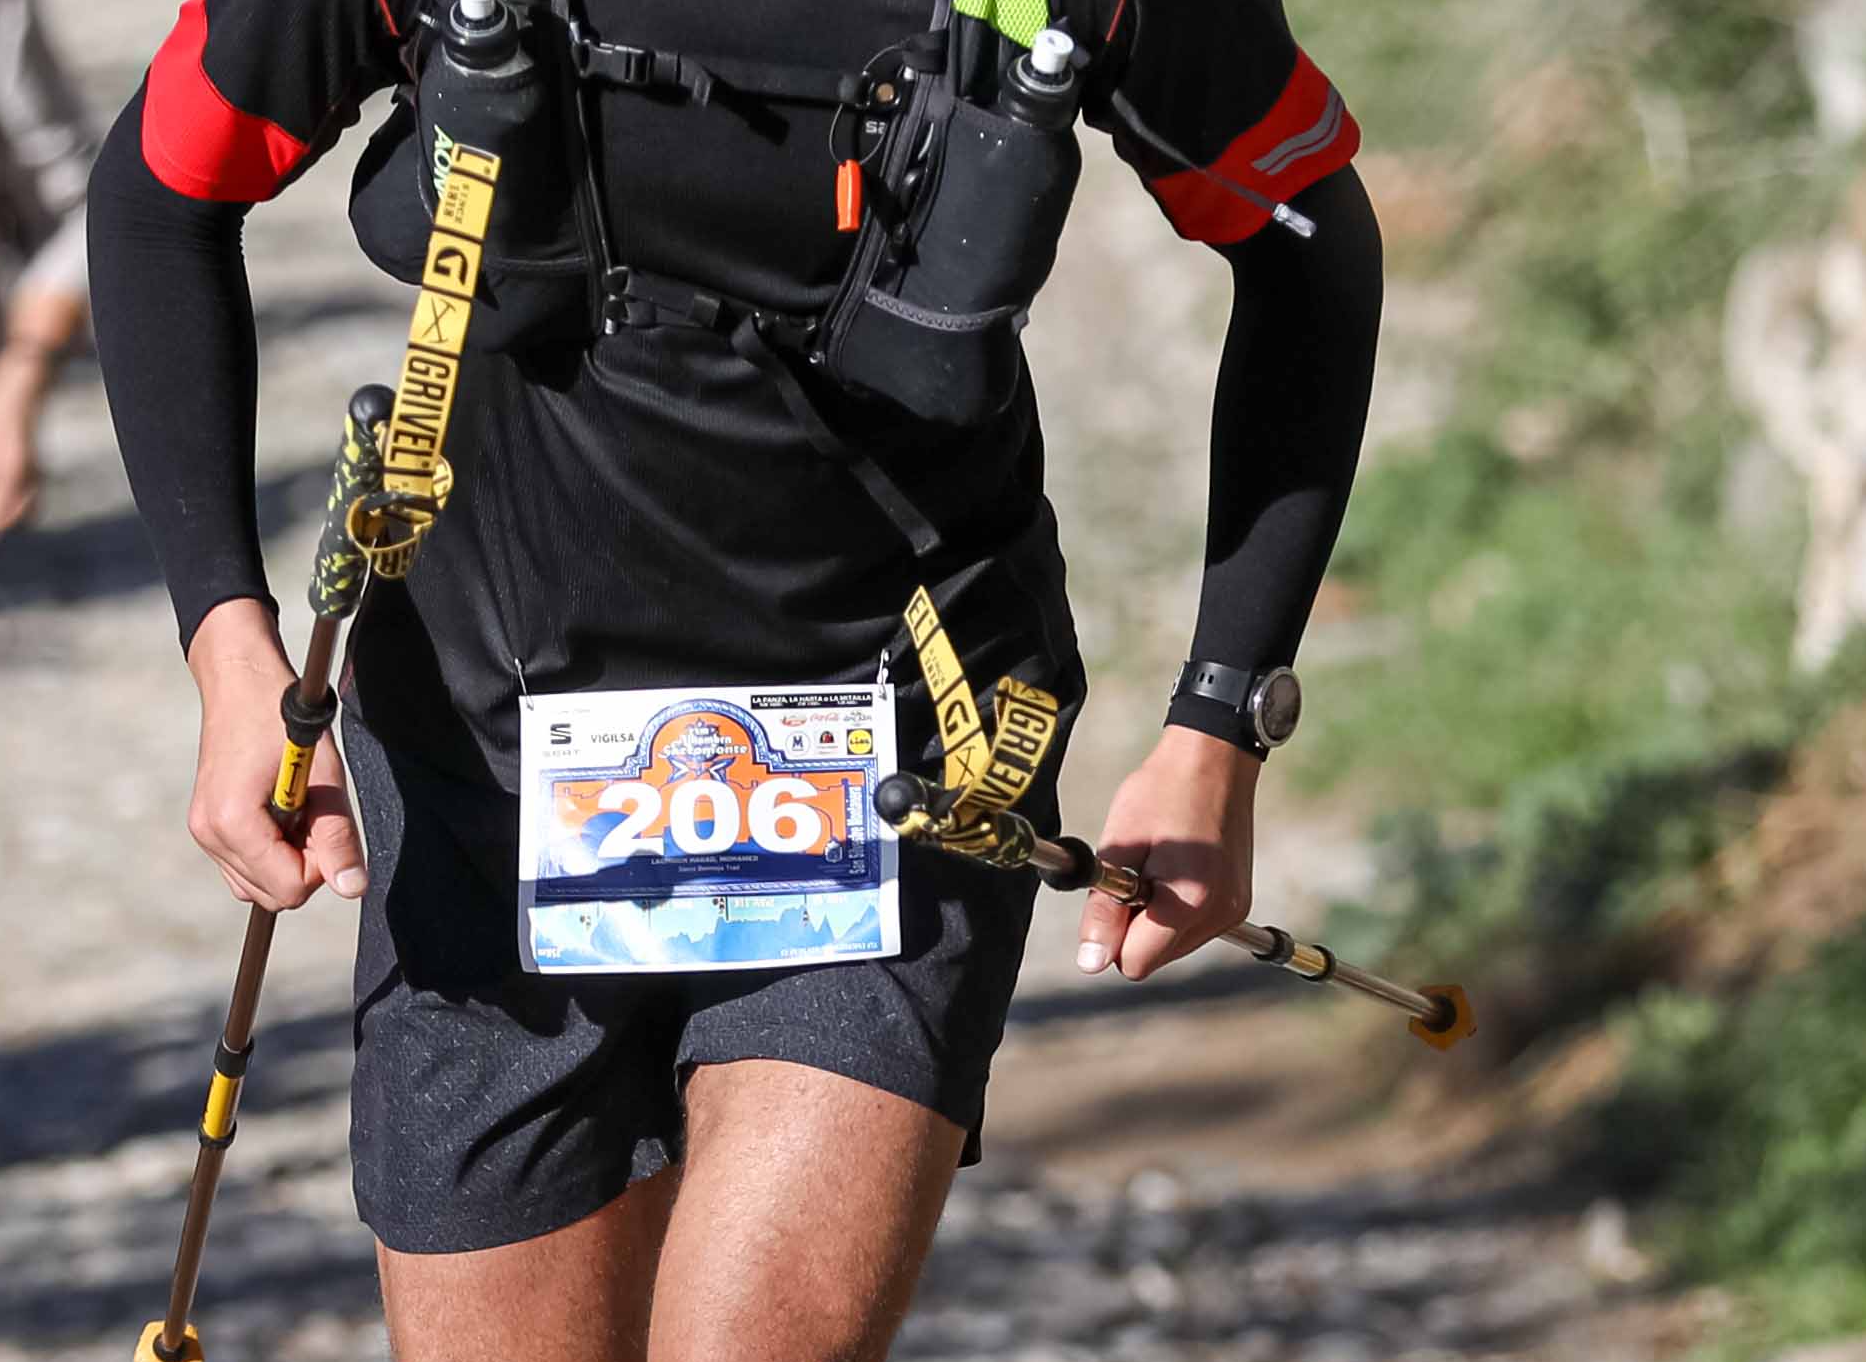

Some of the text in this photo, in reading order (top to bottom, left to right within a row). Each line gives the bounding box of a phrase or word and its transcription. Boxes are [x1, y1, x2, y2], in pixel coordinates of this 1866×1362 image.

[389, 355, 451, 463] GRIVEL
[590, 732, 635, 744] VIGILSA
[597, 778, 823, 858] 206
